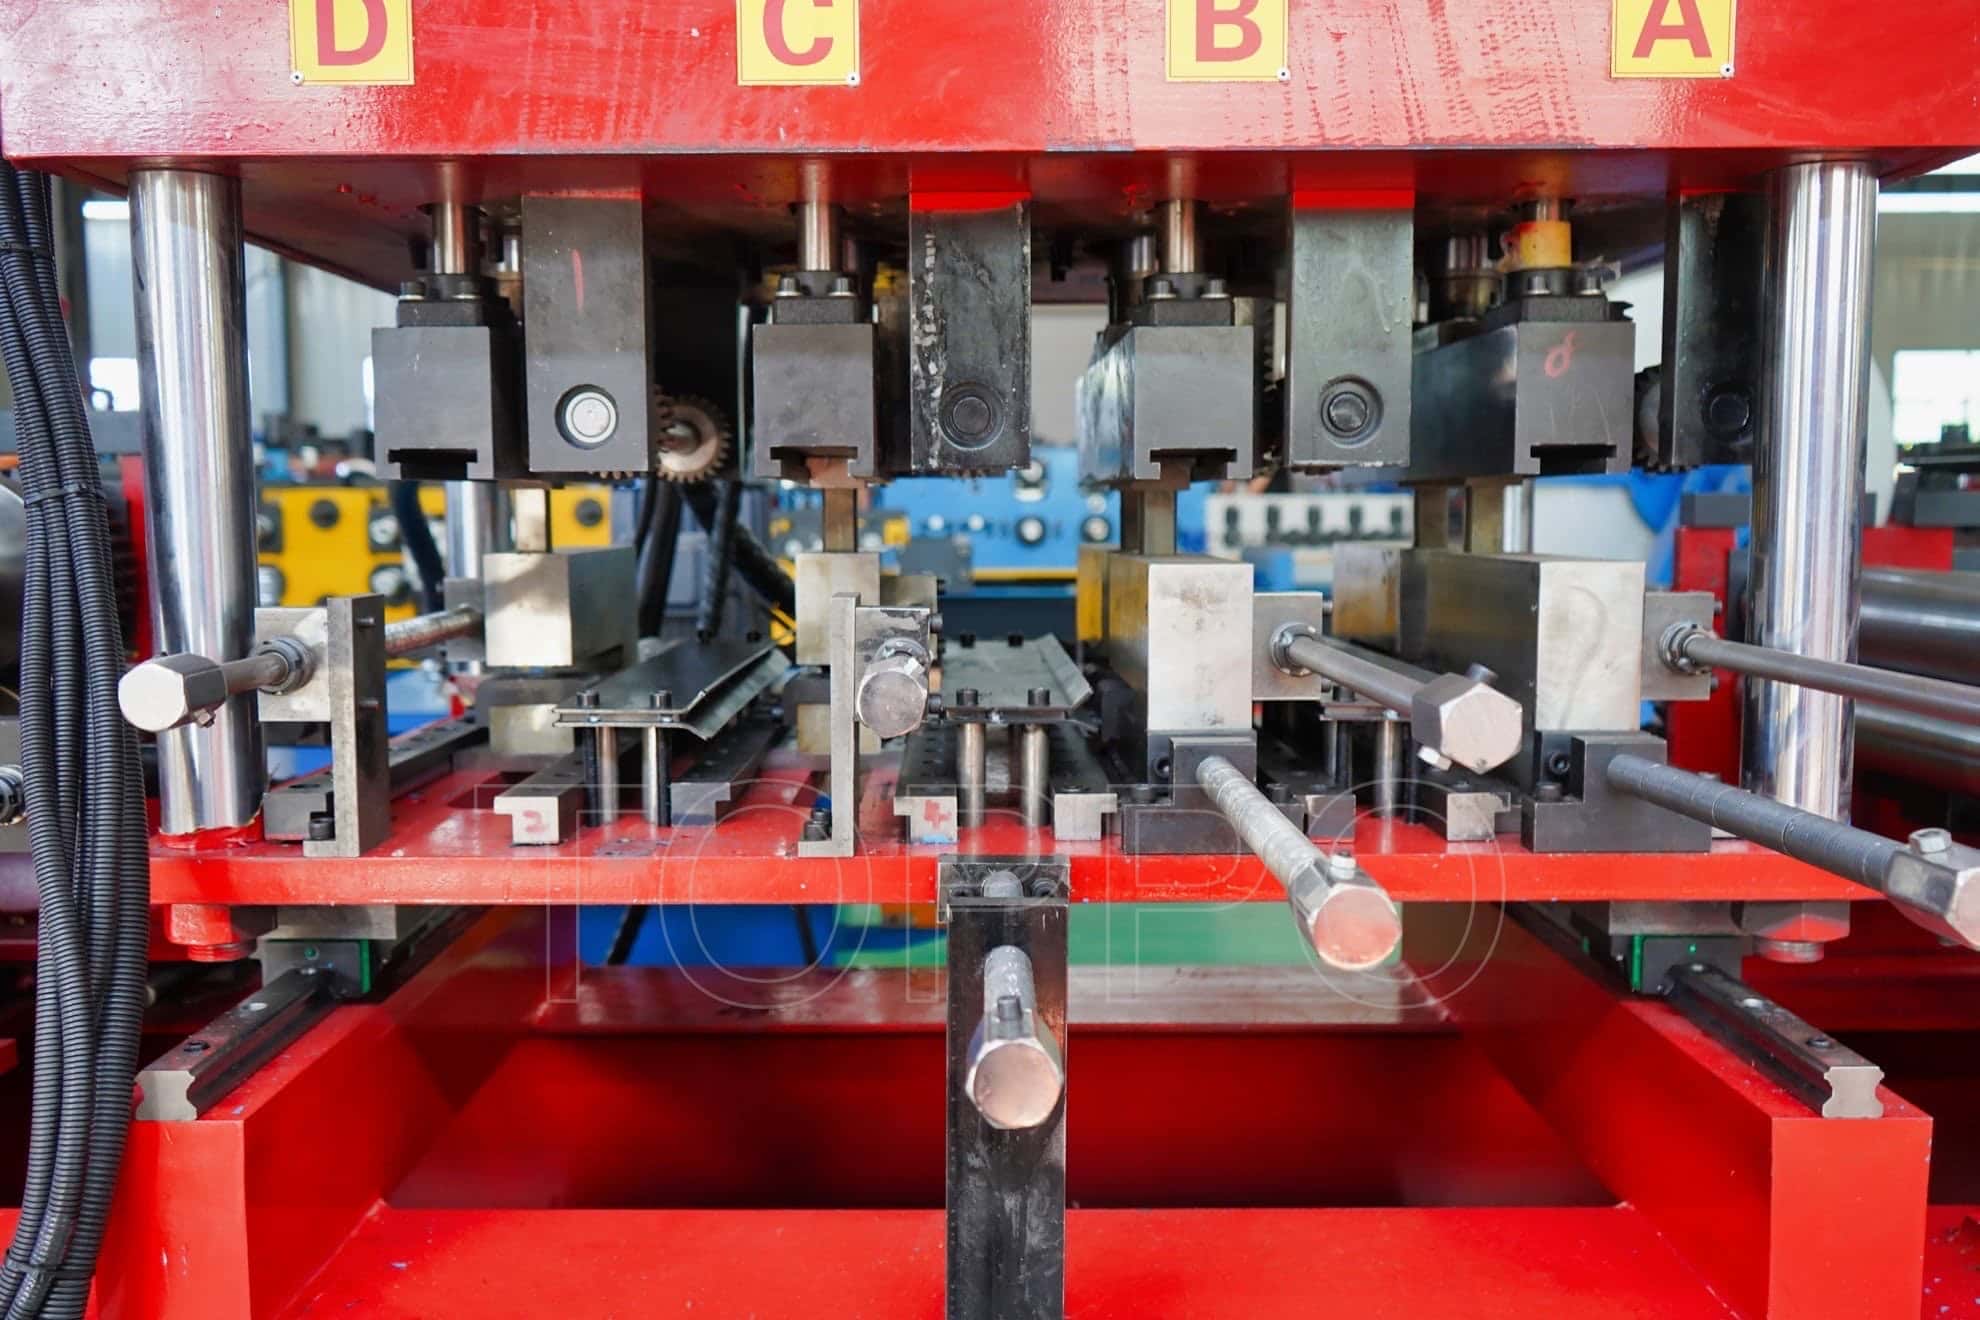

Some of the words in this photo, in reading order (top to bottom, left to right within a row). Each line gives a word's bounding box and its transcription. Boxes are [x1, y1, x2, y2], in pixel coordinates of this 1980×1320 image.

[315, 0, 388, 66] D
[763, 0, 834, 65] C
[1195, 0, 1263, 62] B
[1632, 0, 1713, 58] A
